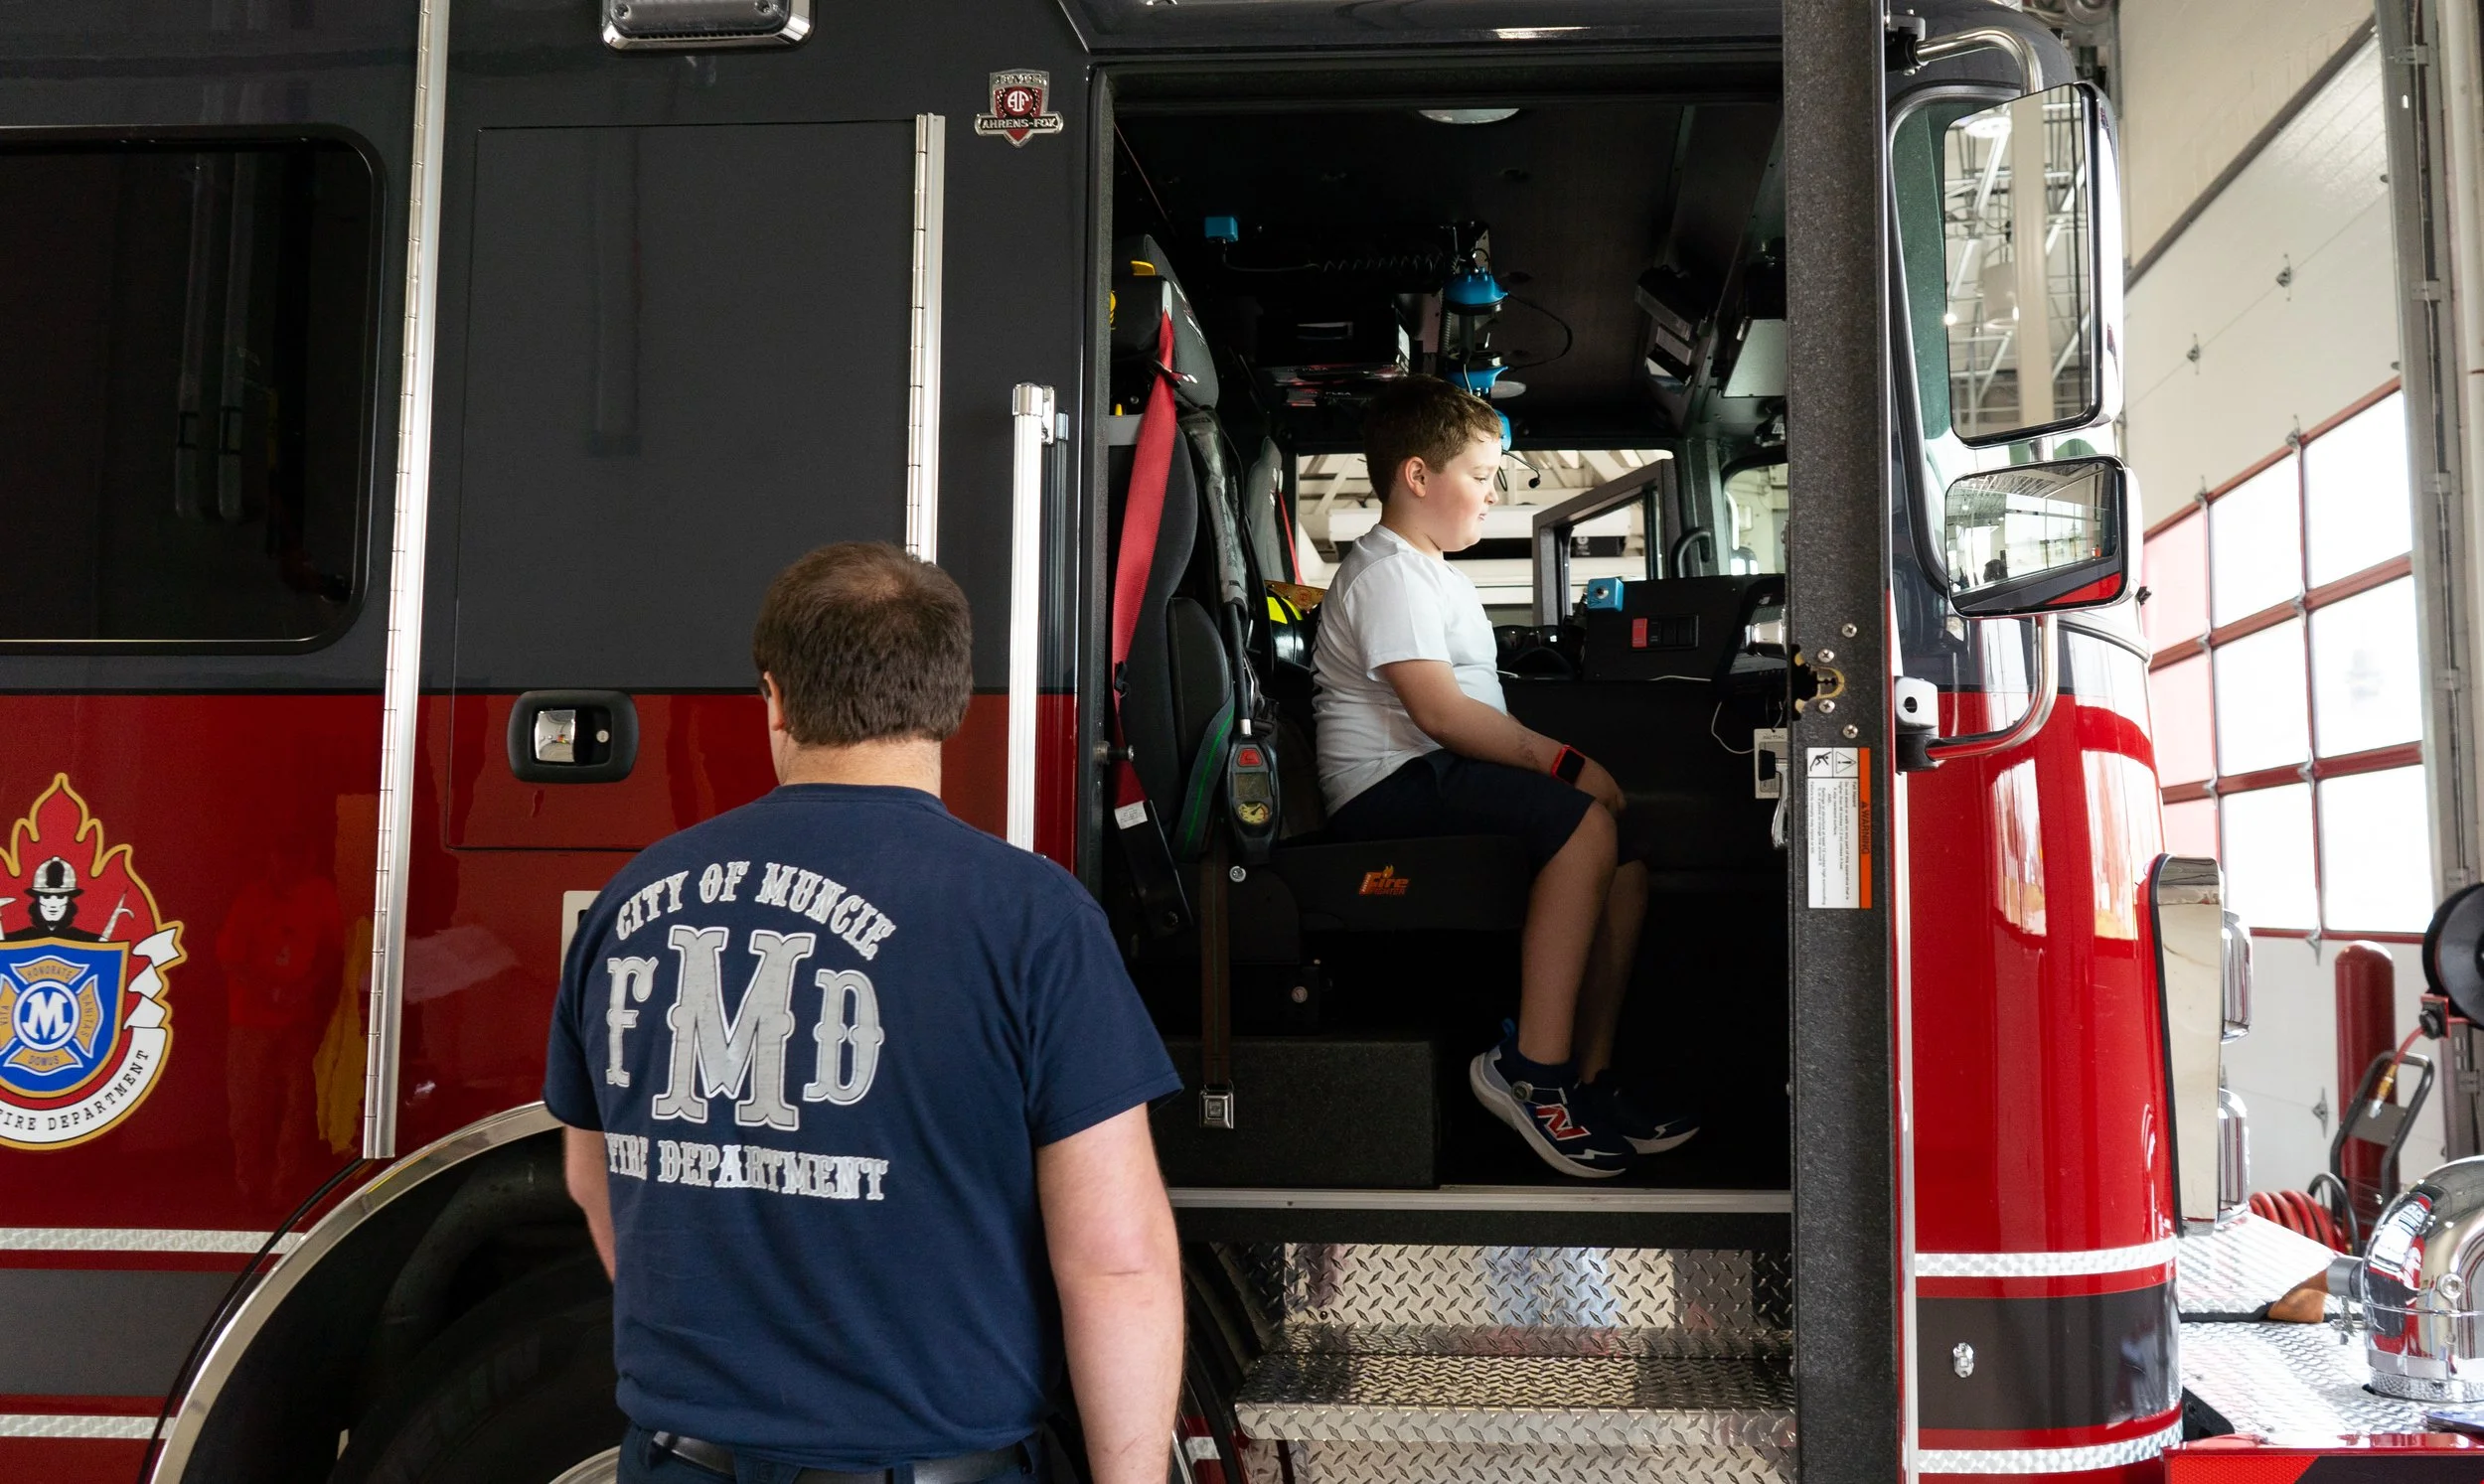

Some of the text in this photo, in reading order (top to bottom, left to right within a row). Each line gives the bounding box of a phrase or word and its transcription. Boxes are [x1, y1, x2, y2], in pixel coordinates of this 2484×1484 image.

[982, 117, 1057, 129] AHRENS-FOX
[1860, 810, 1870, 855] WARNING
[616, 861, 896, 961] CITY OF MUNCIE
[22, 991, 71, 1040] M
[48, 1050, 149, 1130] DEPARTMENT
[604, 1132, 888, 1201] FIRE DEPARTMENT
